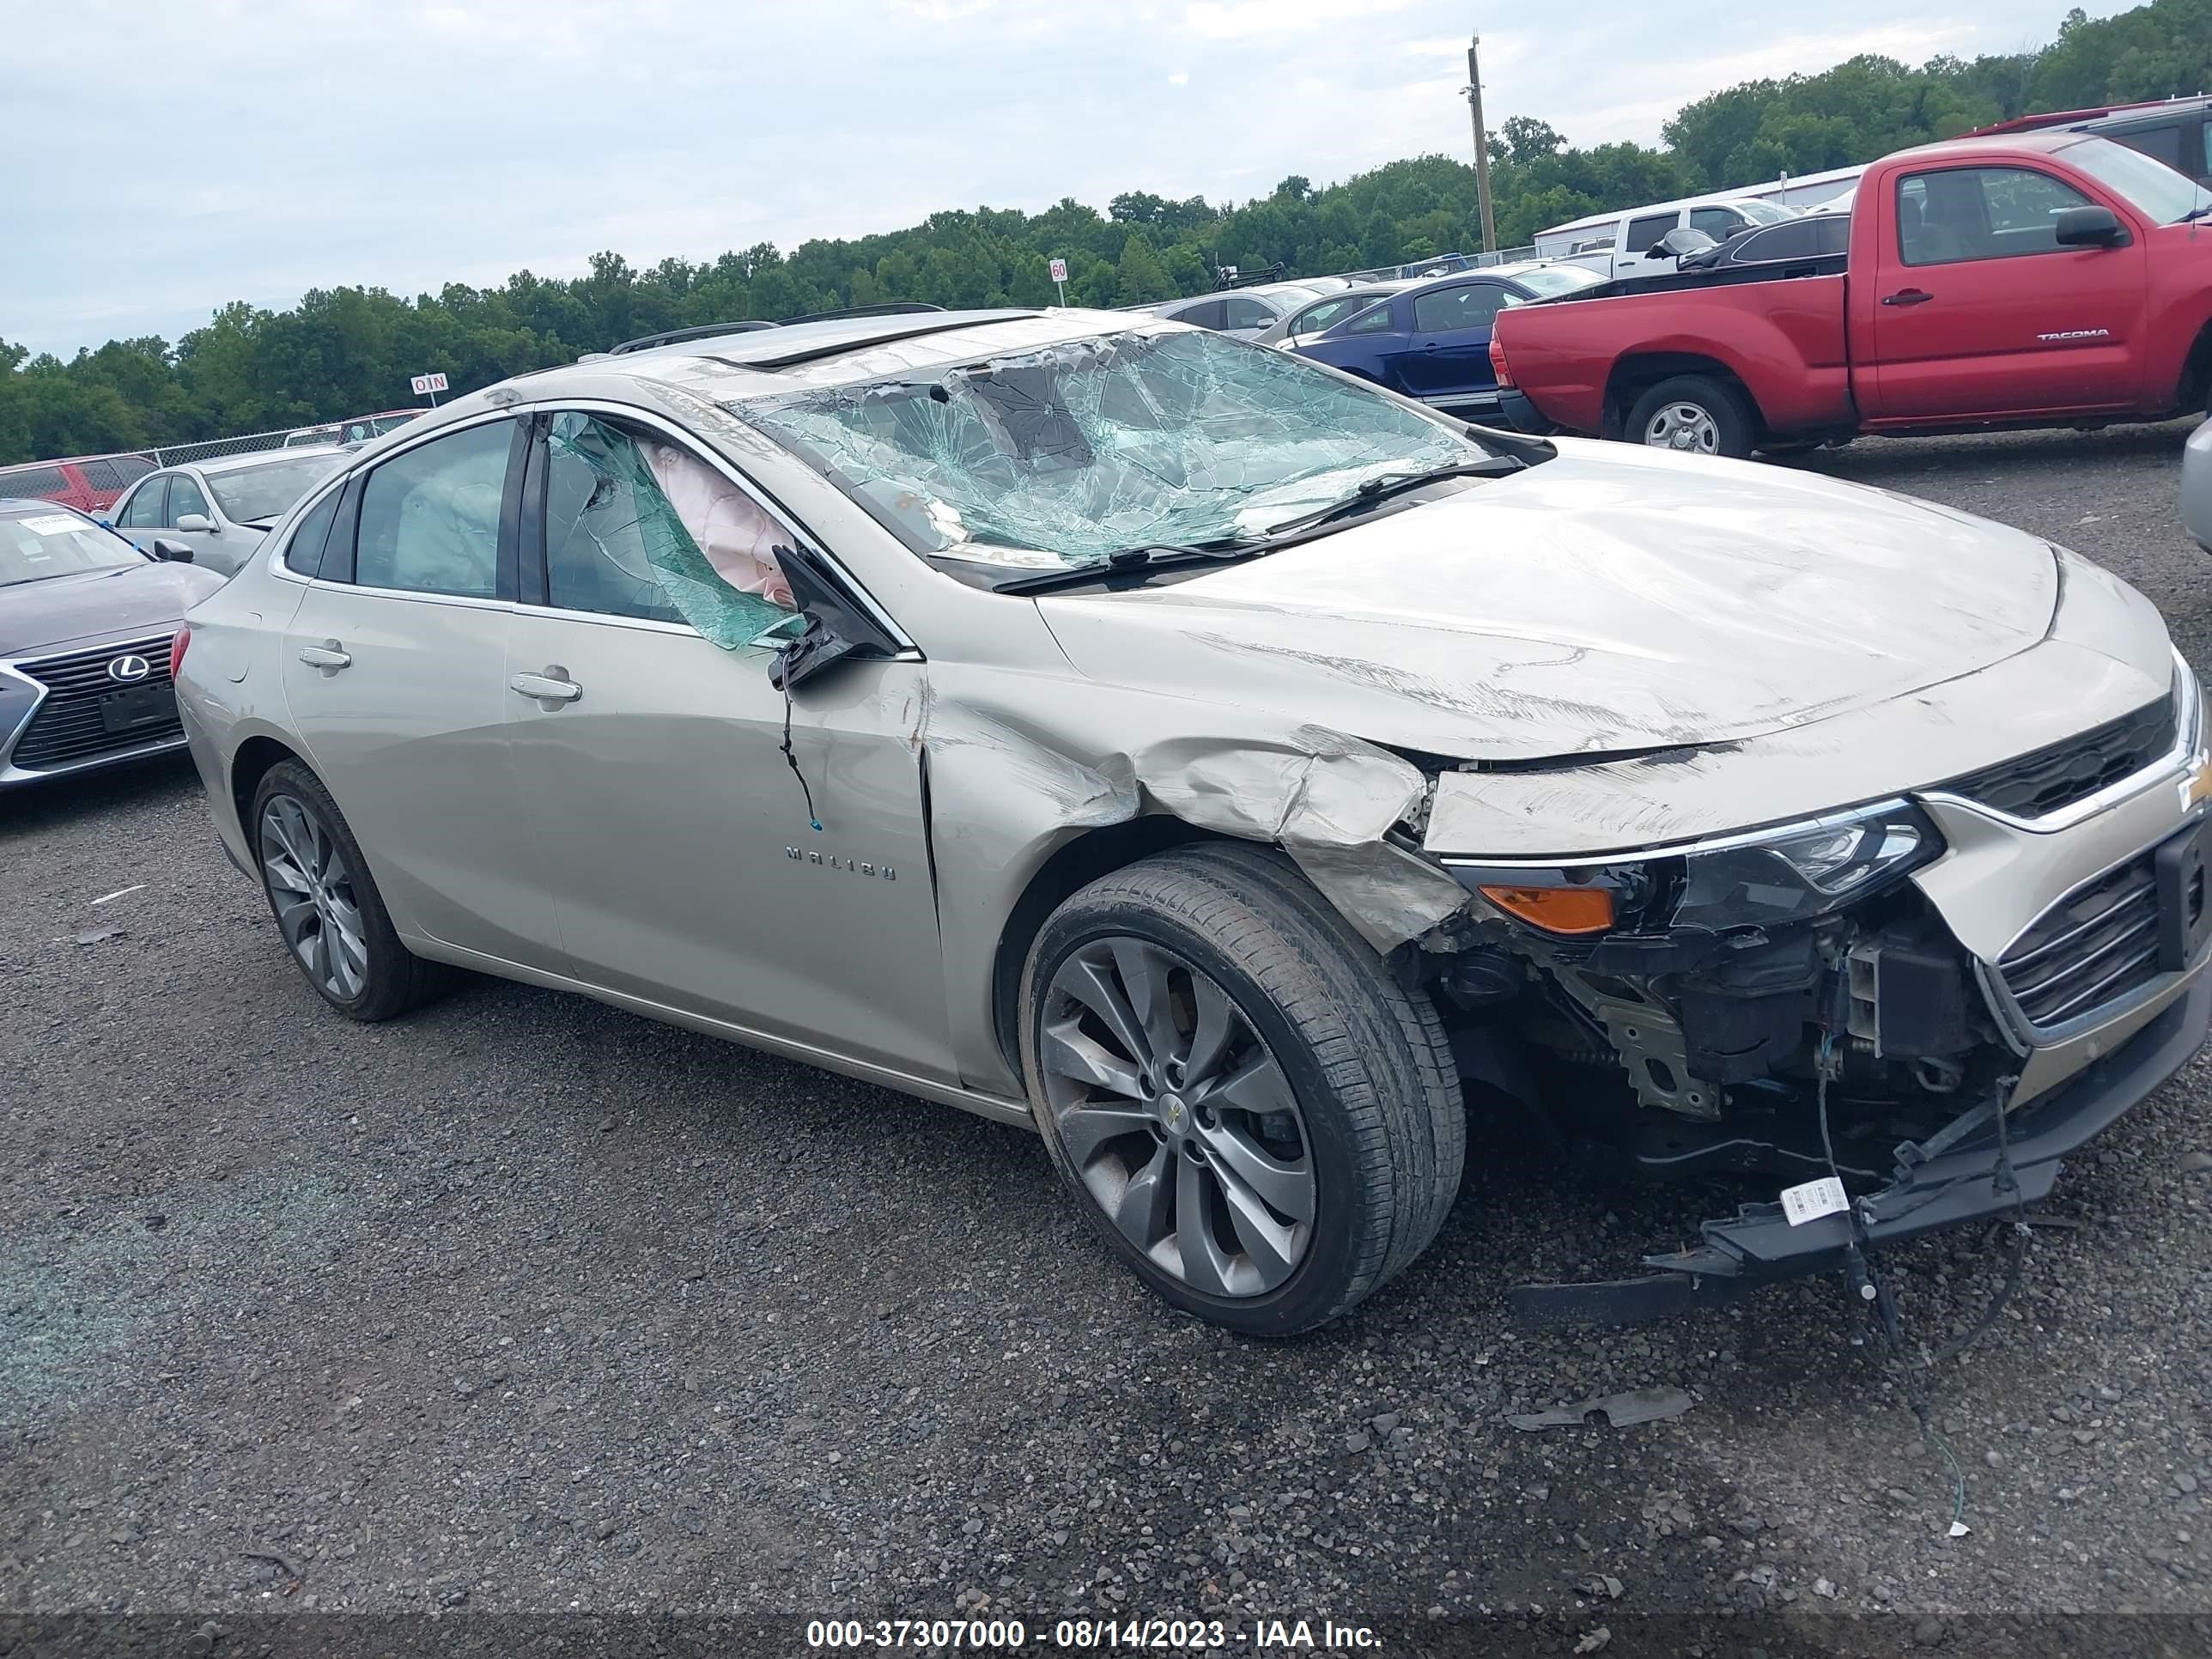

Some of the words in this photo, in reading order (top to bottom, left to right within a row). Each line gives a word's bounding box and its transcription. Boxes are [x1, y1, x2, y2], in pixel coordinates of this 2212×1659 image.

[1052, 264, 1066, 276] 60
[2037, 329, 2110, 341] TACOMA
[785, 846, 896, 881] MALIBU
